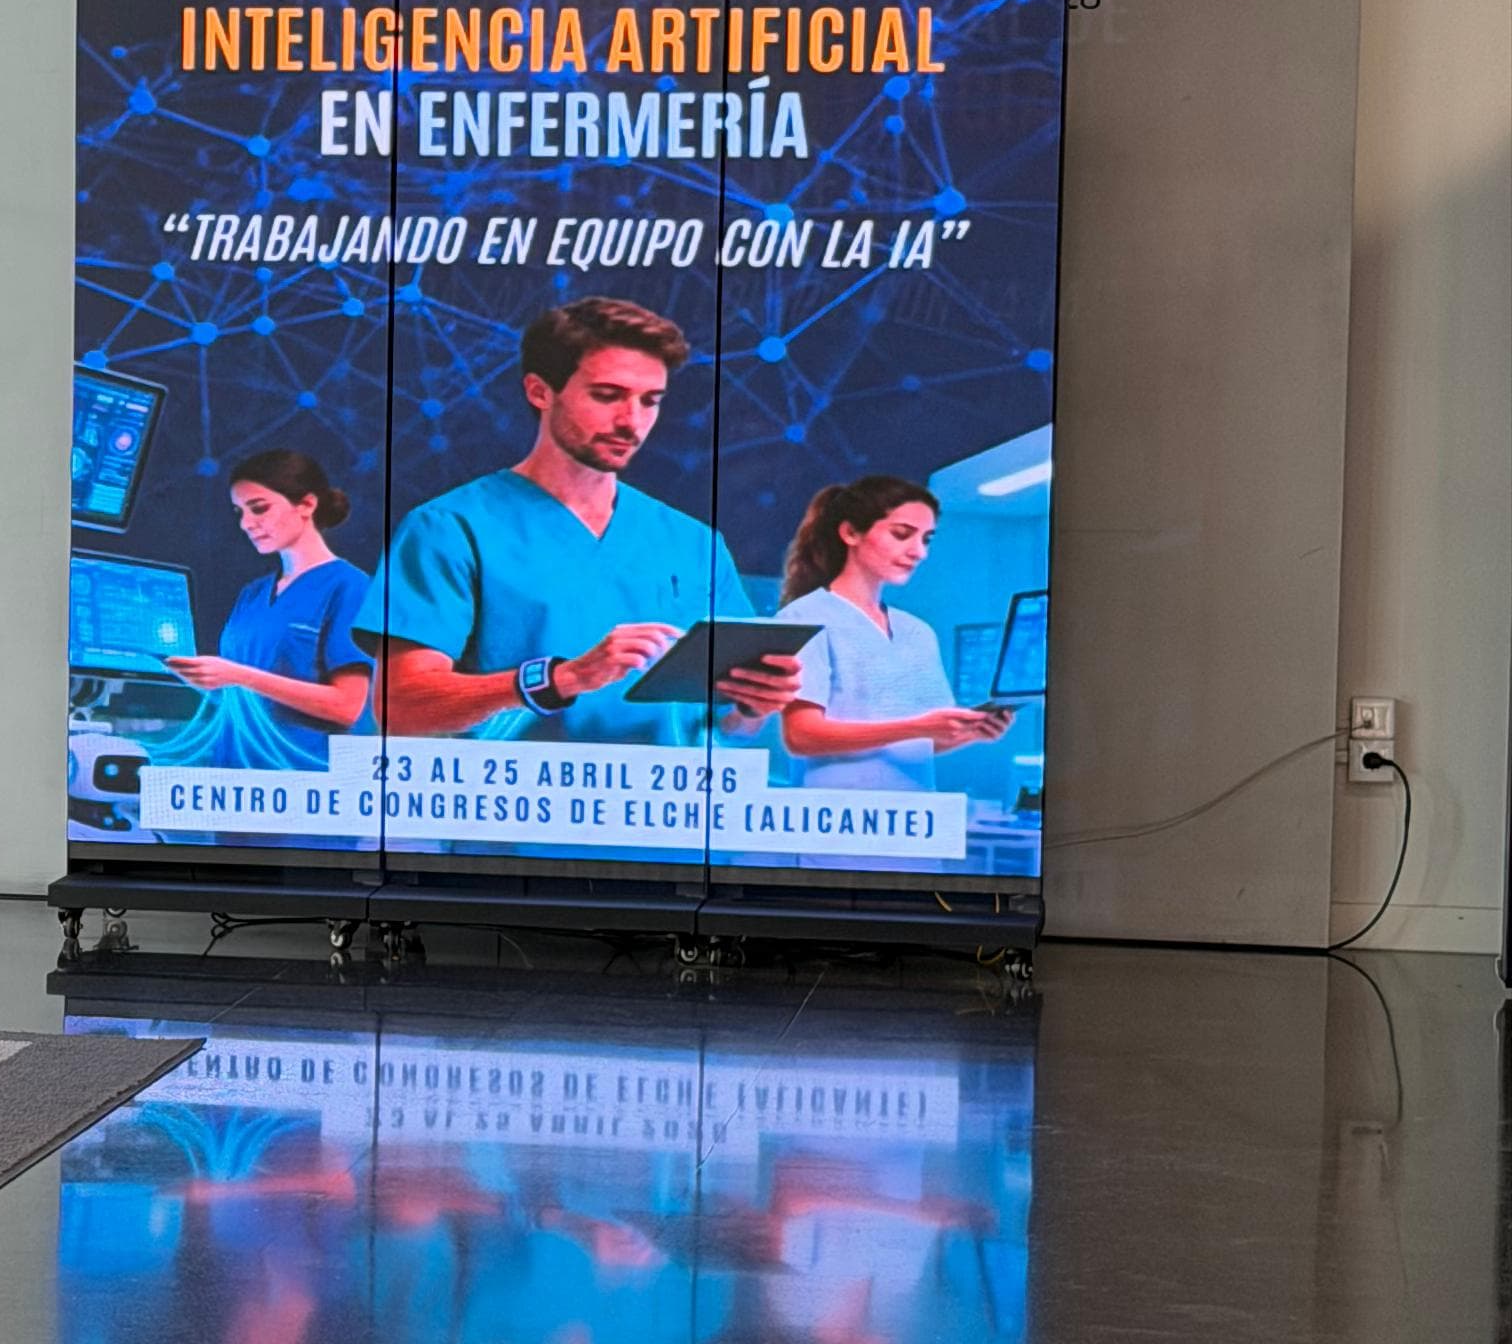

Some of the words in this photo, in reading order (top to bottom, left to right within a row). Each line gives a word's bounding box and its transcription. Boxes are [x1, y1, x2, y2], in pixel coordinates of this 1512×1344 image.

[181, 7, 588, 73] INTELIGENCIA
[606, 7, 946, 74] ARTIFICIAL
[320, 89, 393, 156] EN
[418, 75, 809, 159] ENFERMERÍA
[163, 213, 468, 265] “TRABAJANDO
[477, 217, 538, 266] EN
[546, 217, 704, 272] EQUIPO
[720, 218, 814, 268] CON
[820, 219, 874, 269] LA
[888, 219, 971, 269] IA”
[371, 754, 413, 783] 23
[429, 756, 465, 784] AL
[482, 758, 519, 786] 25
[536, 760, 633, 790] ABRIL
[649, 763, 738, 794] 2026
[170, 783, 288, 814] CENTRO
[306, 788, 341, 816] DE
[358, 790, 552, 824] CONGRESOS
[569, 797, 606, 825] DE
[624, 799, 725, 831] ELCHE
[743, 802, 934, 839] (ALICANTE)
